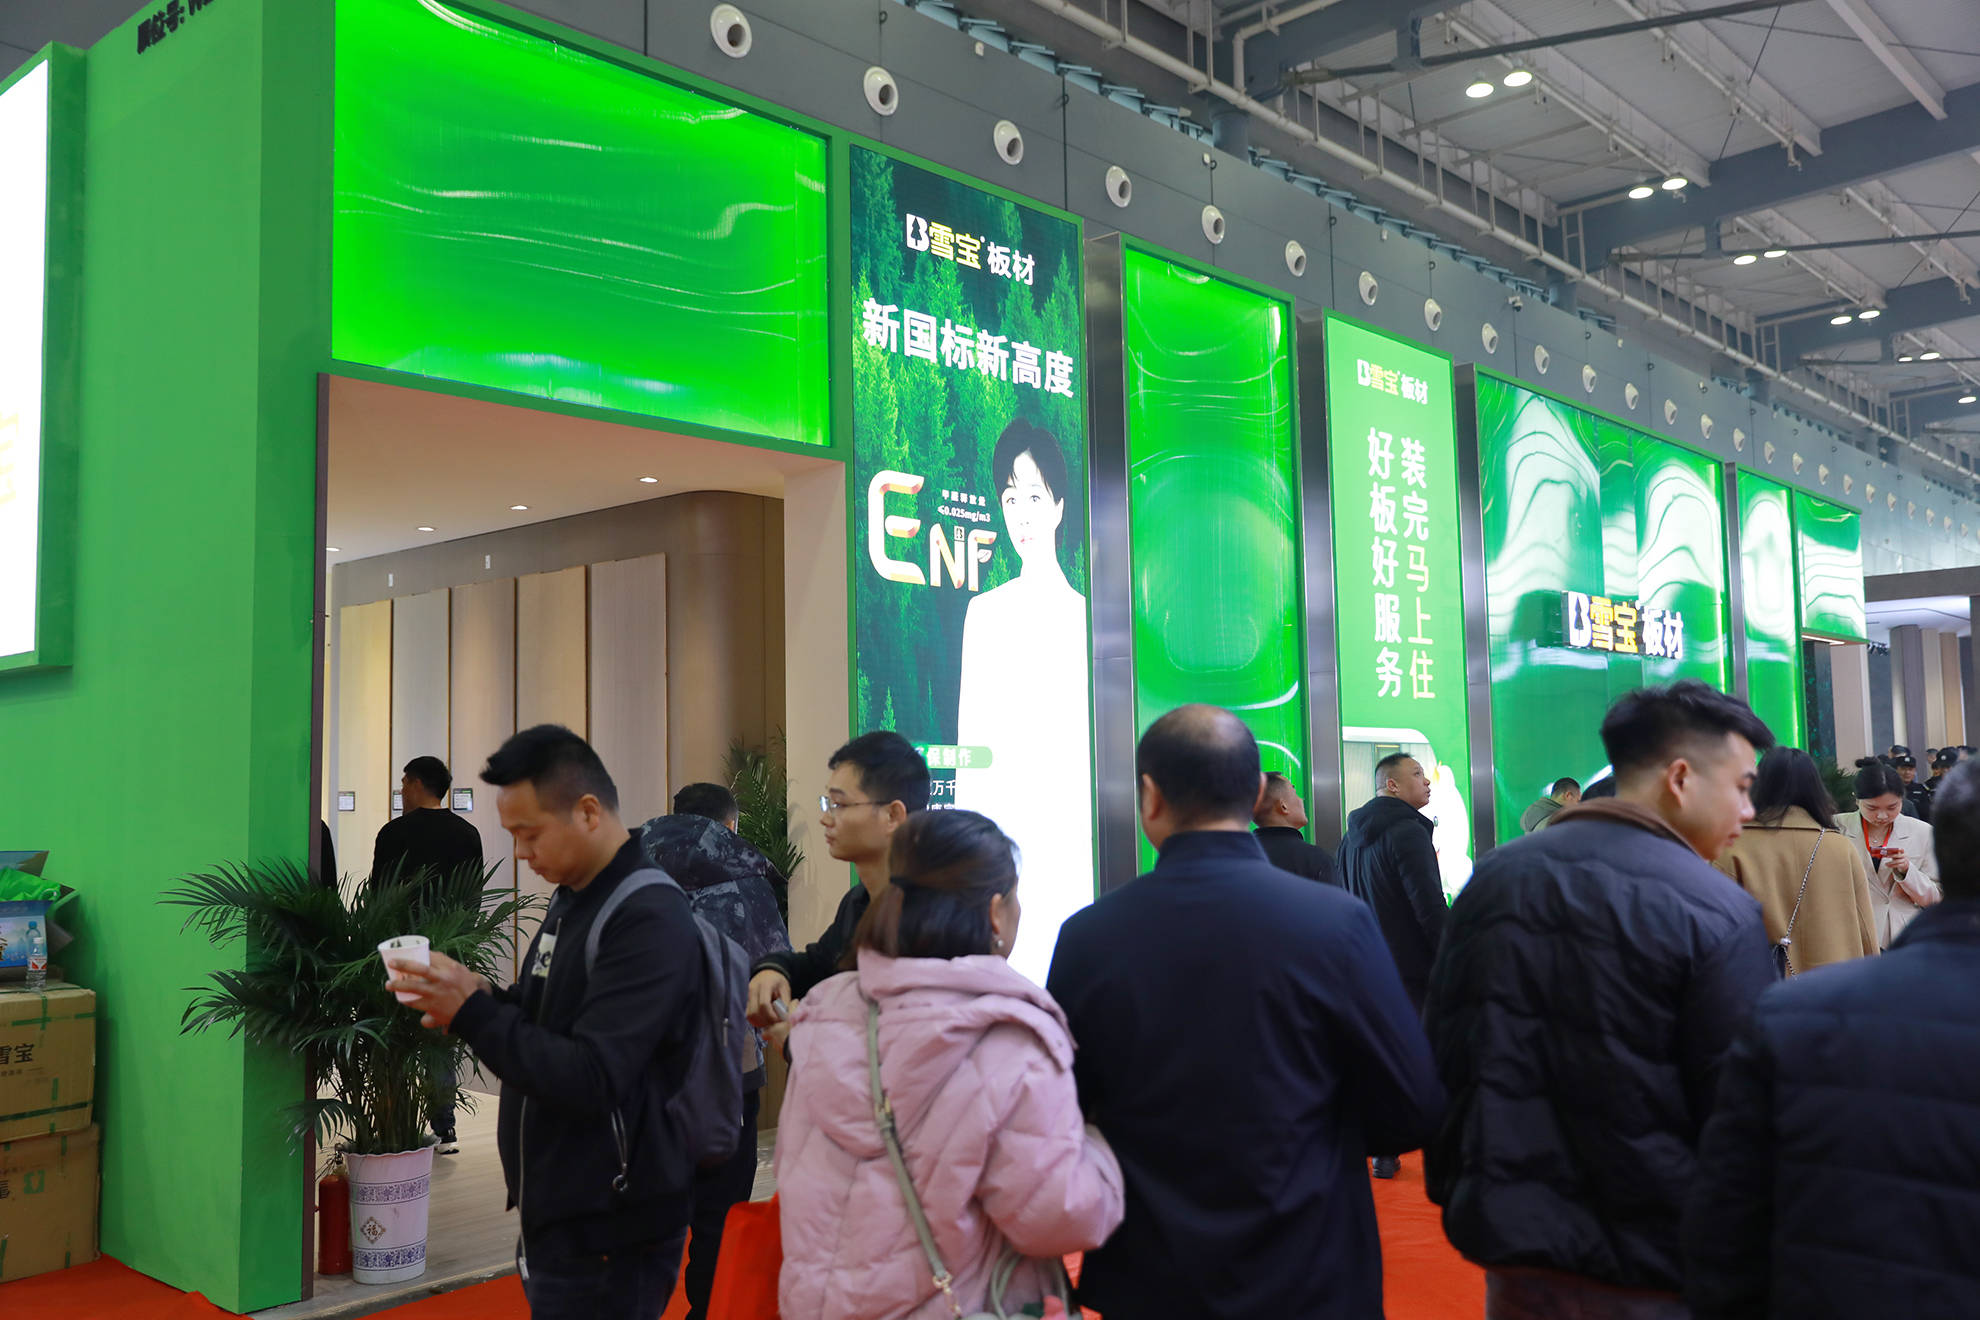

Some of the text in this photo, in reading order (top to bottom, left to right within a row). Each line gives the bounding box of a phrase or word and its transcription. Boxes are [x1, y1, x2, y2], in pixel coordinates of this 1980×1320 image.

[862, 297, 1074, 398] 新国标新高度
[1367, 426, 1403, 698] 好板好服务
[1400, 437, 1436, 699] 装完马上住
[929, 780, 956, 796] 万千
